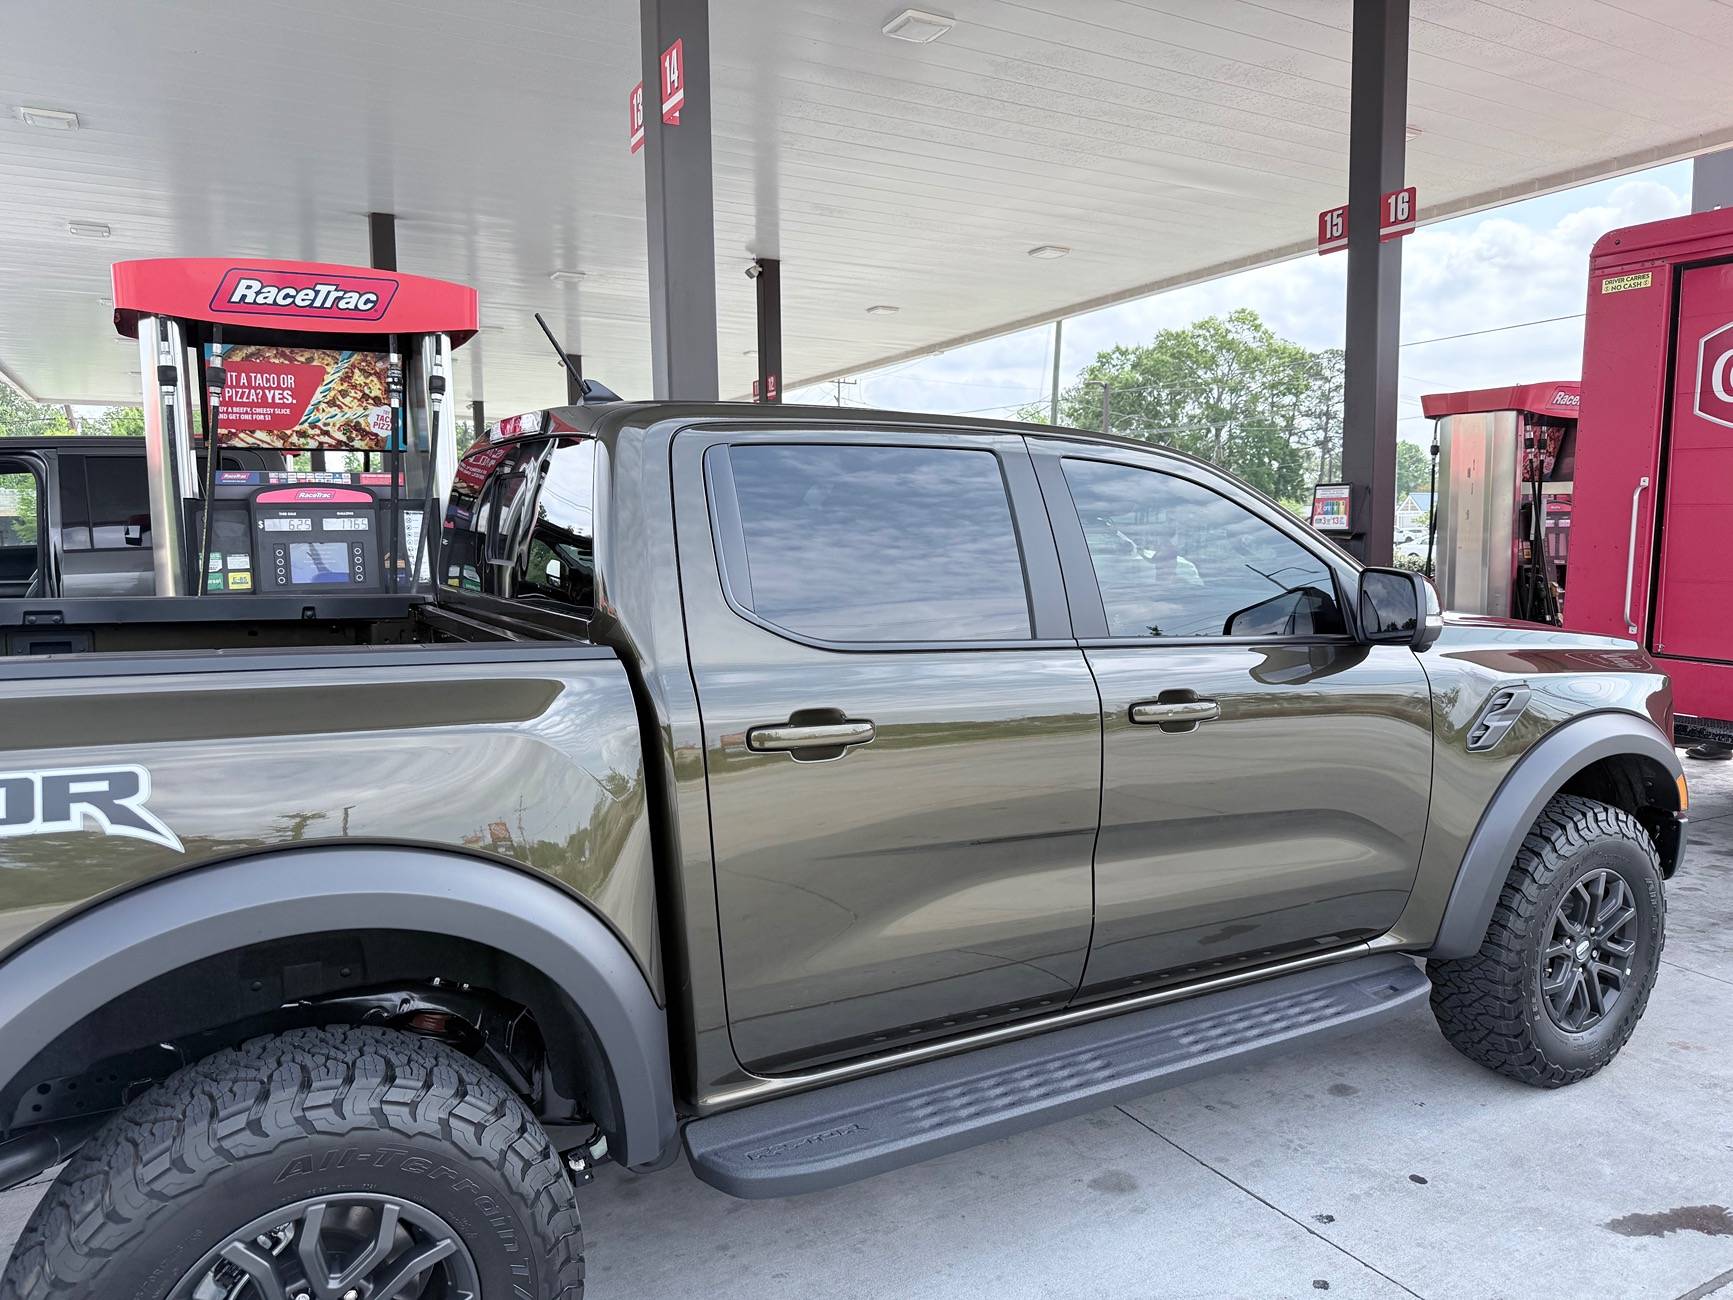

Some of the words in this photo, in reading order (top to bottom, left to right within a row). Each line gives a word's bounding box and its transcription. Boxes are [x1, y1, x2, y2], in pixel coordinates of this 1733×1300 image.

[664, 47, 679, 96] 14
[633, 87, 643, 130] 13
[1388, 191, 1410, 223] 16
[1325, 210, 1344, 240] 15
[1604, 278, 1625, 286] DRIVER
[1626, 274, 1650, 282] CARRIES
[1623, 281, 1642, 289] CASH
[228, 277, 380, 311] RaceTrac
[227, 372, 237, 386] IT
[240, 373, 248, 386] A
[250, 373, 277, 388] TACO
[280, 375, 295, 388] OR
[225, 388, 263, 402] PIZZA?
[265, 390, 297, 404] YES.
[1552, 391, 1580, 405] Race
[376, 414, 391, 423] TAC
[373, 422, 392, 431] PIZZ
[298, 491, 332, 499] RaceTrac
[258, 521, 264, 529] $
